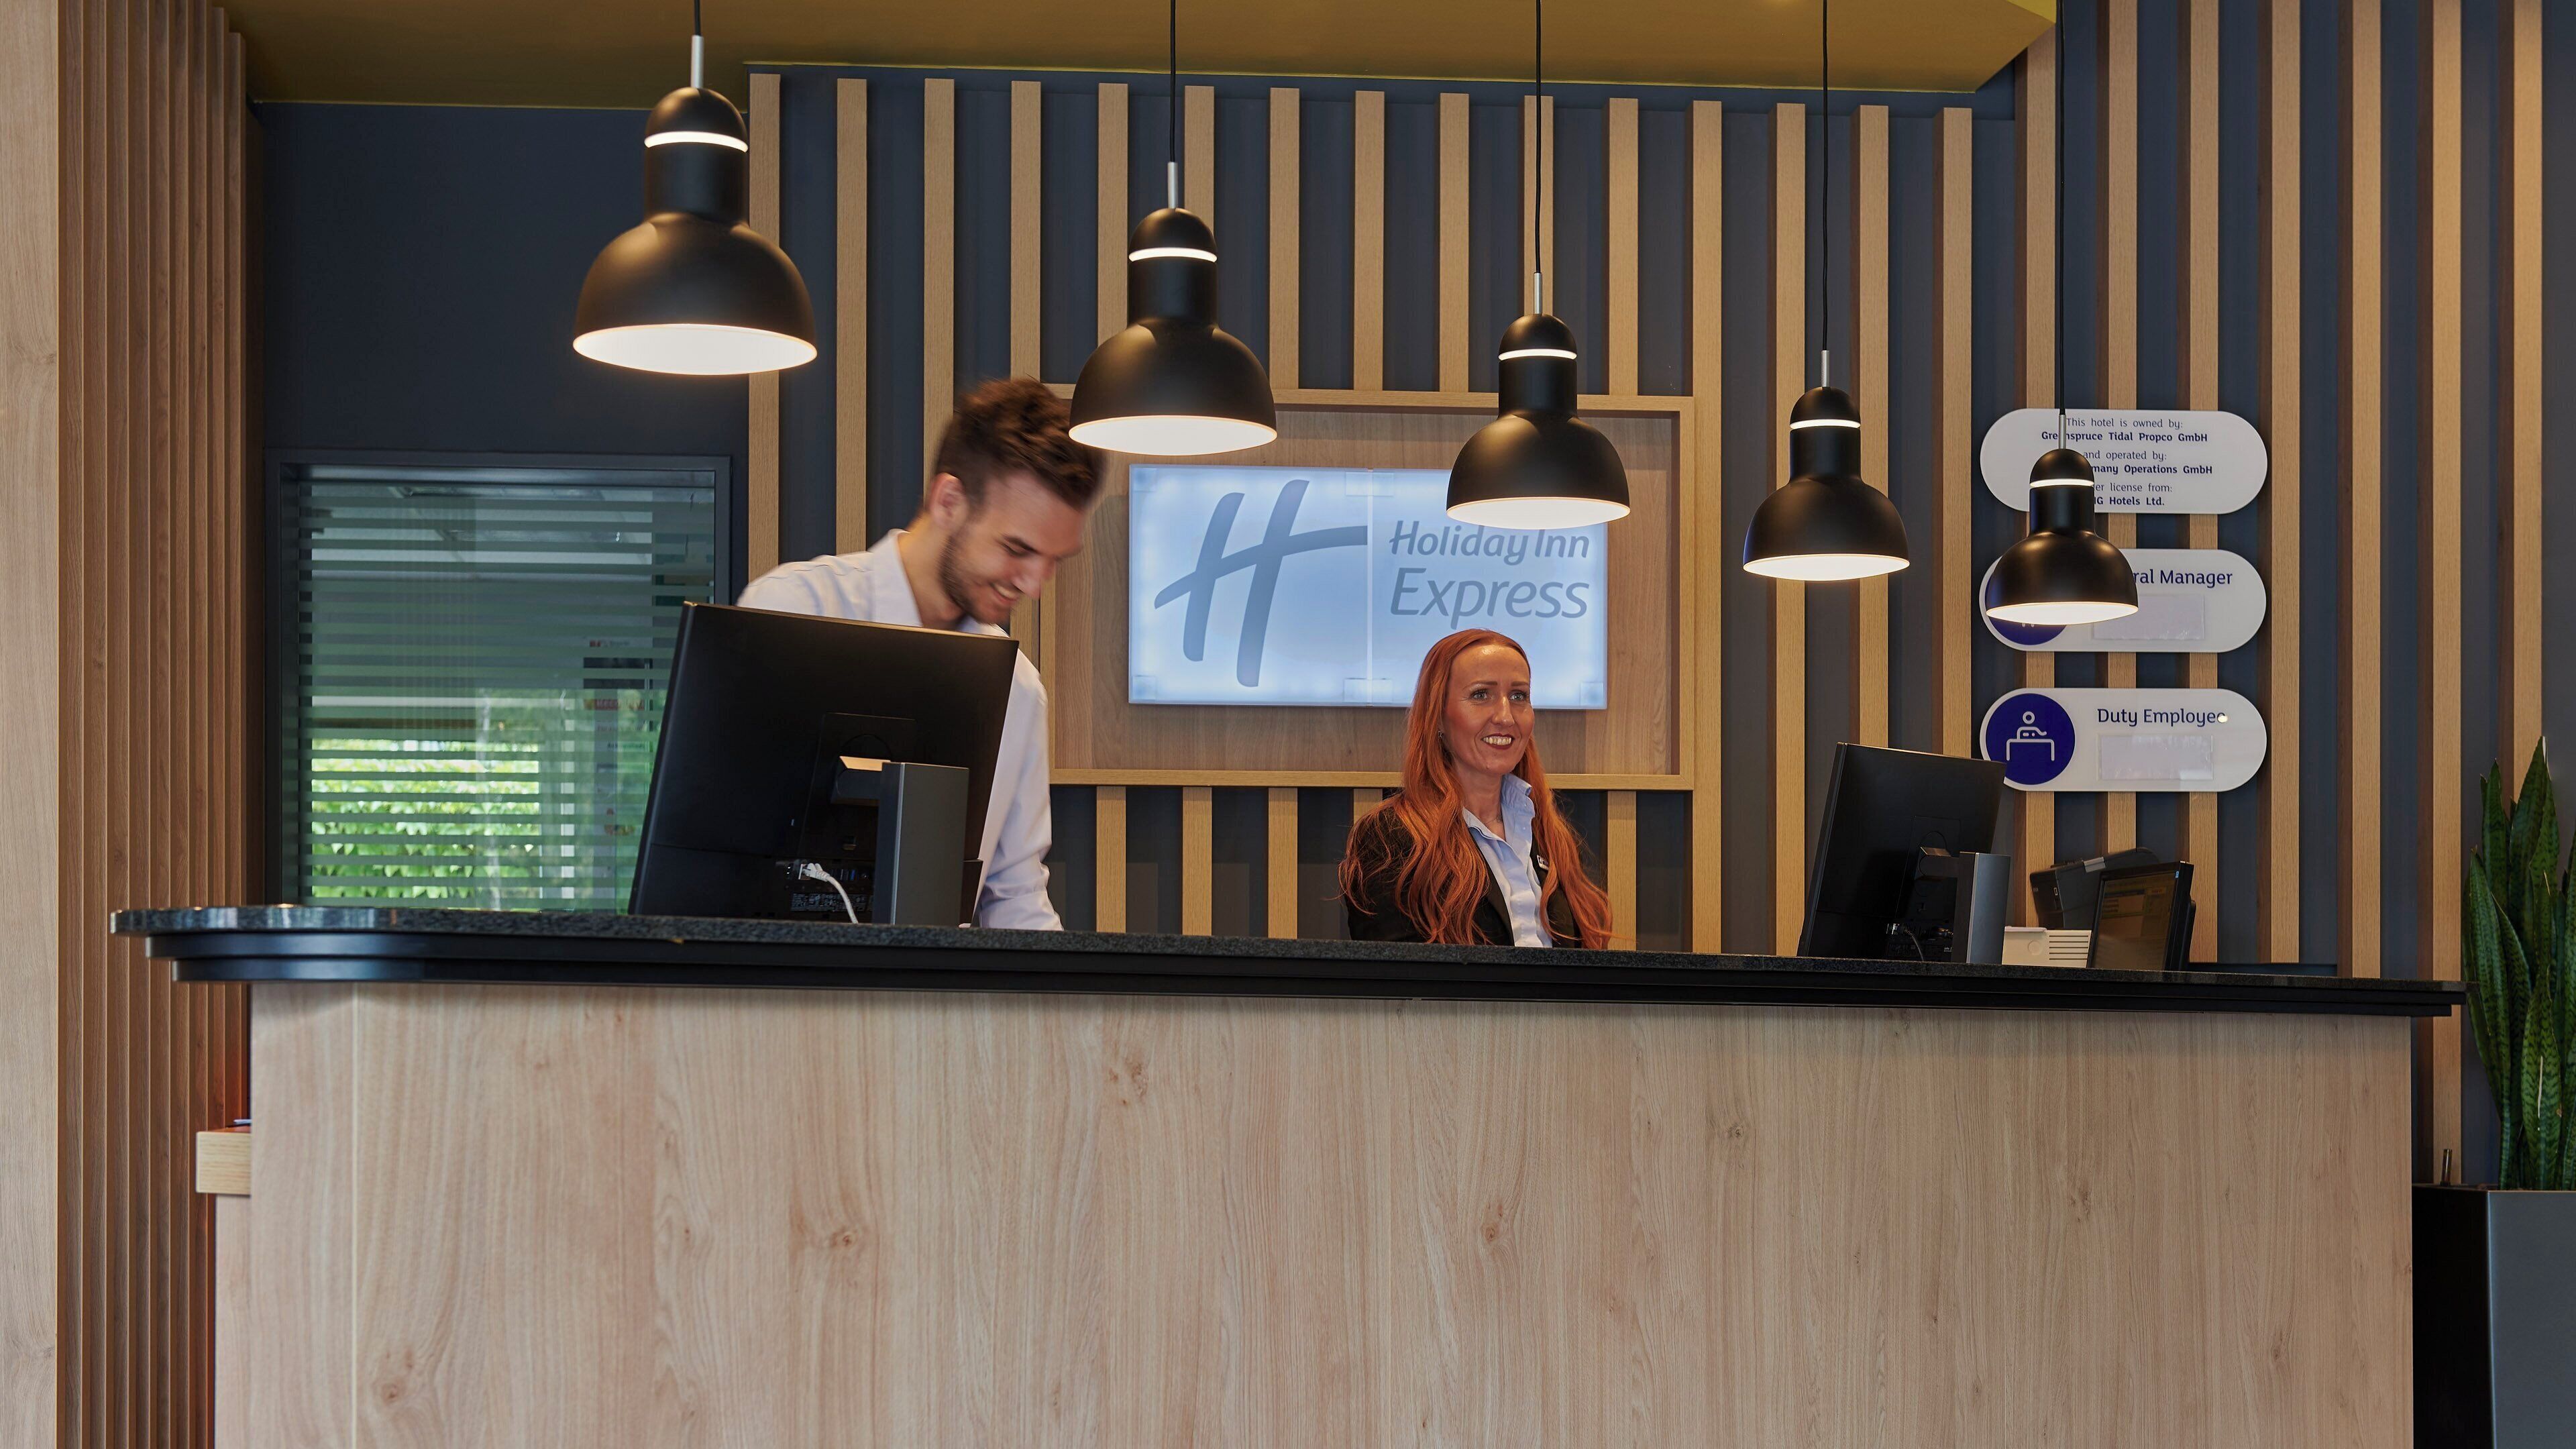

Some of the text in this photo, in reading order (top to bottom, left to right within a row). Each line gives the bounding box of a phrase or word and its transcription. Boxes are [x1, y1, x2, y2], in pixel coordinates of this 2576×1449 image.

[2066, 417, 2183, 430] This hotel is owned by:
[2041, 431, 2208, 443] Grenspruce Tidal Propco GmbH
[2083, 450, 2167, 462] and operated by:
[2124, 465, 2178, 475] Operations
[2183, 465, 2212, 474] GmbH
[2110, 483, 2143, 492] license
[2148, 483, 2173, 492] from:
[2109, 496, 2141, 505] Hotels
[2146, 496, 2165, 506] Ltd.
[1389, 520, 1590, 566] Holiday Inn
[2160, 570, 2233, 588] Manager
[1390, 568, 1590, 630] Express
[2097, 708, 2137, 727] Duty
